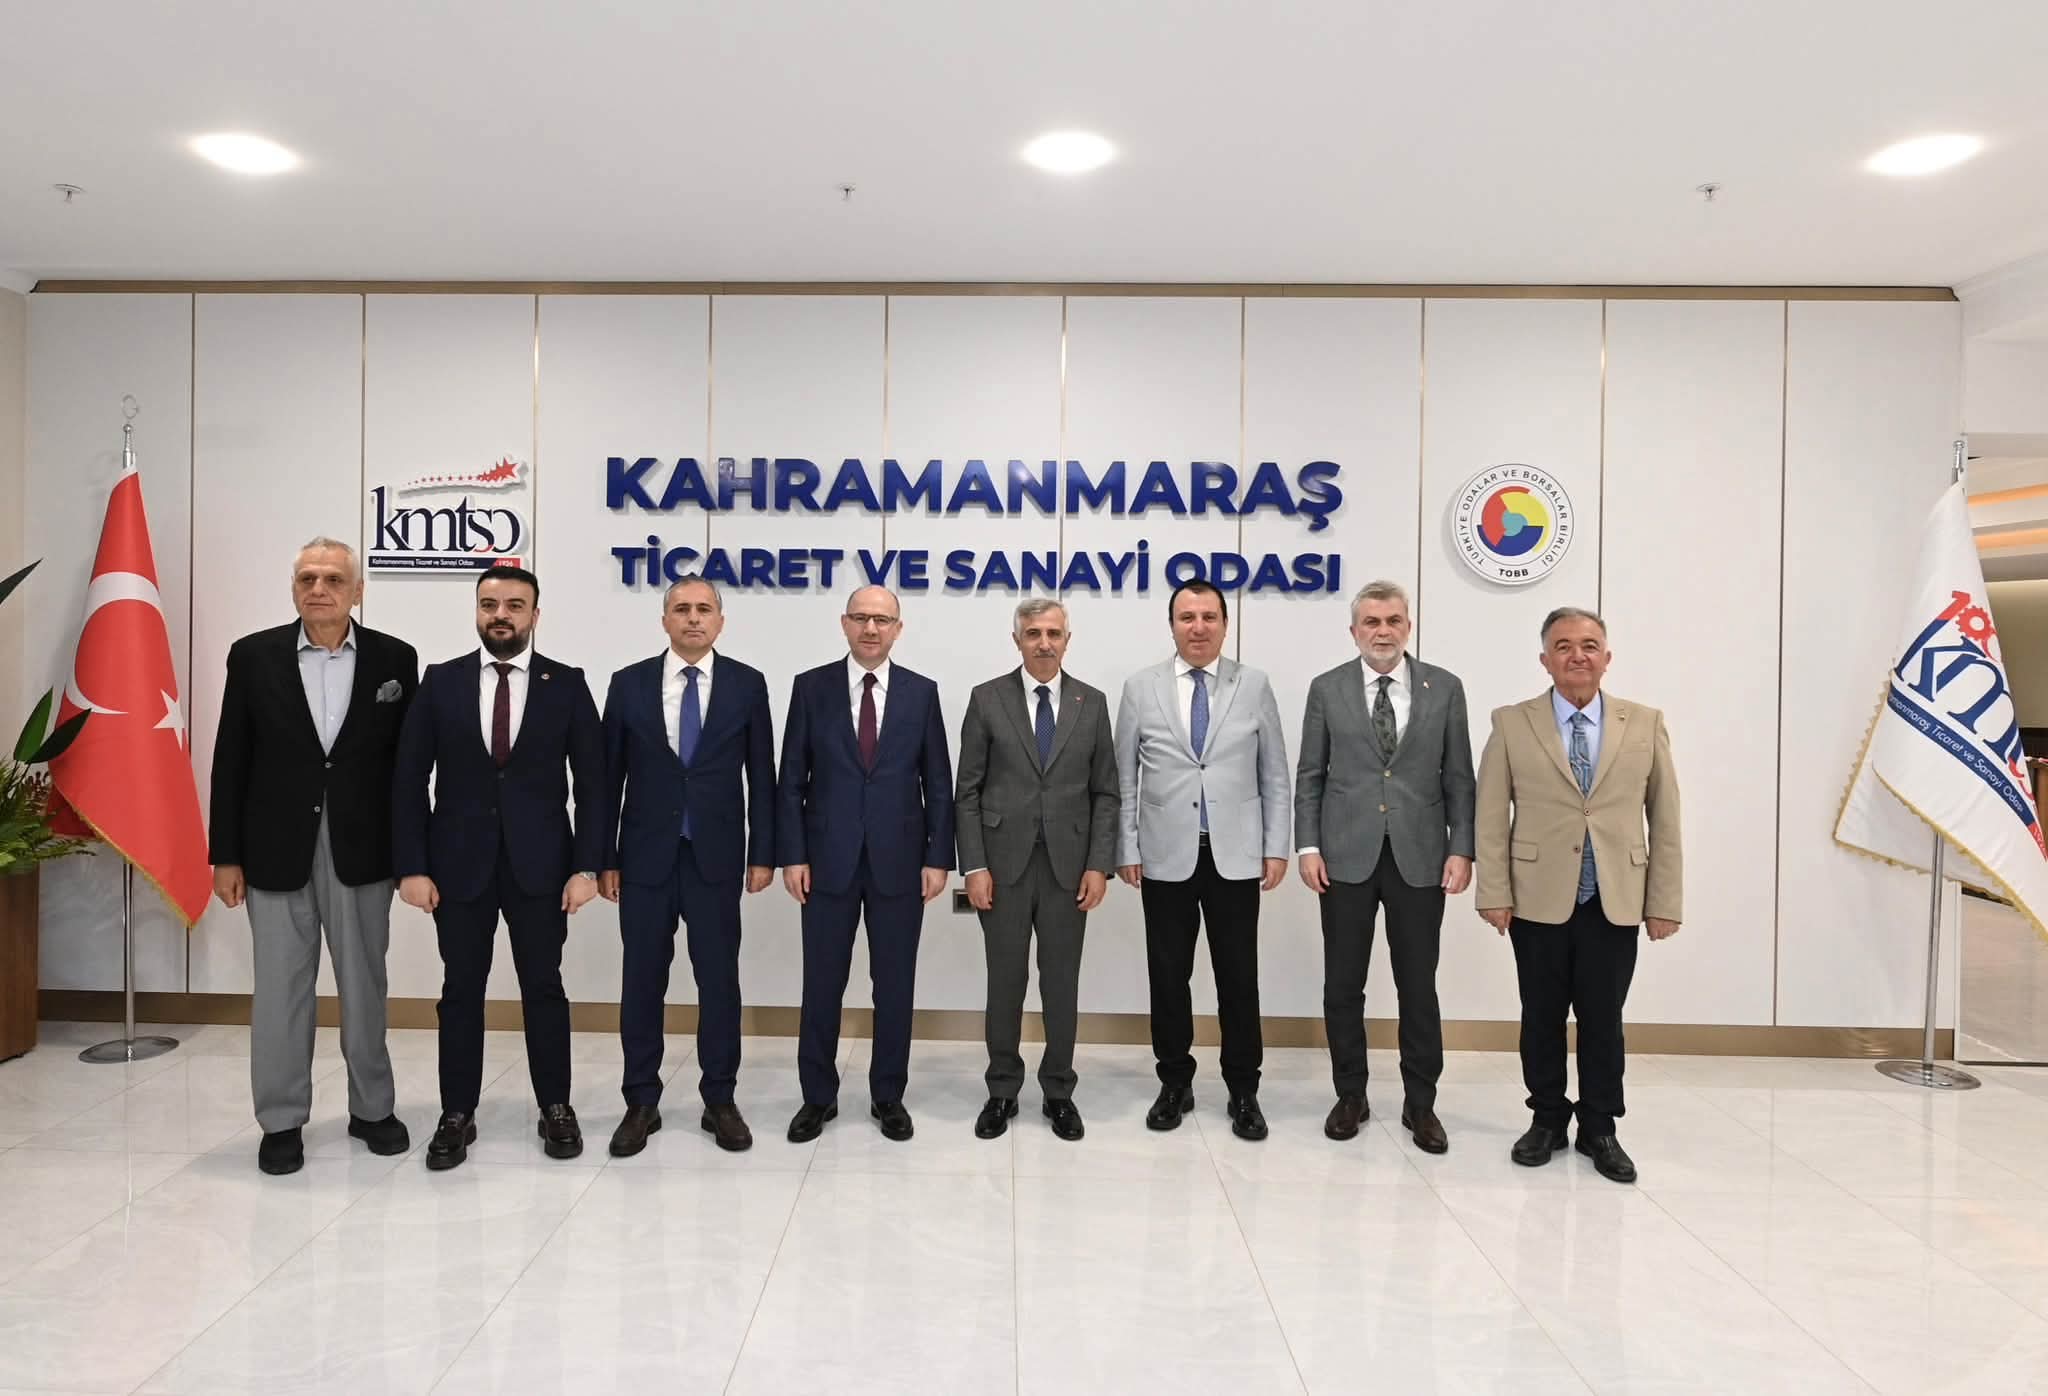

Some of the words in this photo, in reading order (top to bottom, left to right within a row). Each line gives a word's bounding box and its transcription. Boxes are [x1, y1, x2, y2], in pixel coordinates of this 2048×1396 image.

[606, 457, 1343, 532] KAHRAMANMARAŞ
[1462, 473, 1498, 511] ODALAR
[1502, 469, 1518, 478] VE
[1522, 470, 1567, 520] BORSALAR
[369, 485, 520, 553] kmtso
[1460, 516, 1484, 566] TÜRKİYE
[611, 535, 844, 588] TİCARET
[857, 549, 929, 590] VE
[944, 539, 1149, 592] SANAYİ
[1165, 552, 1341, 593] ODASI
[1498, 568, 1529, 577] TOBB
[1963, 749, 1975, 762] ve
[1974, 758, 2003, 788] Sanayi
